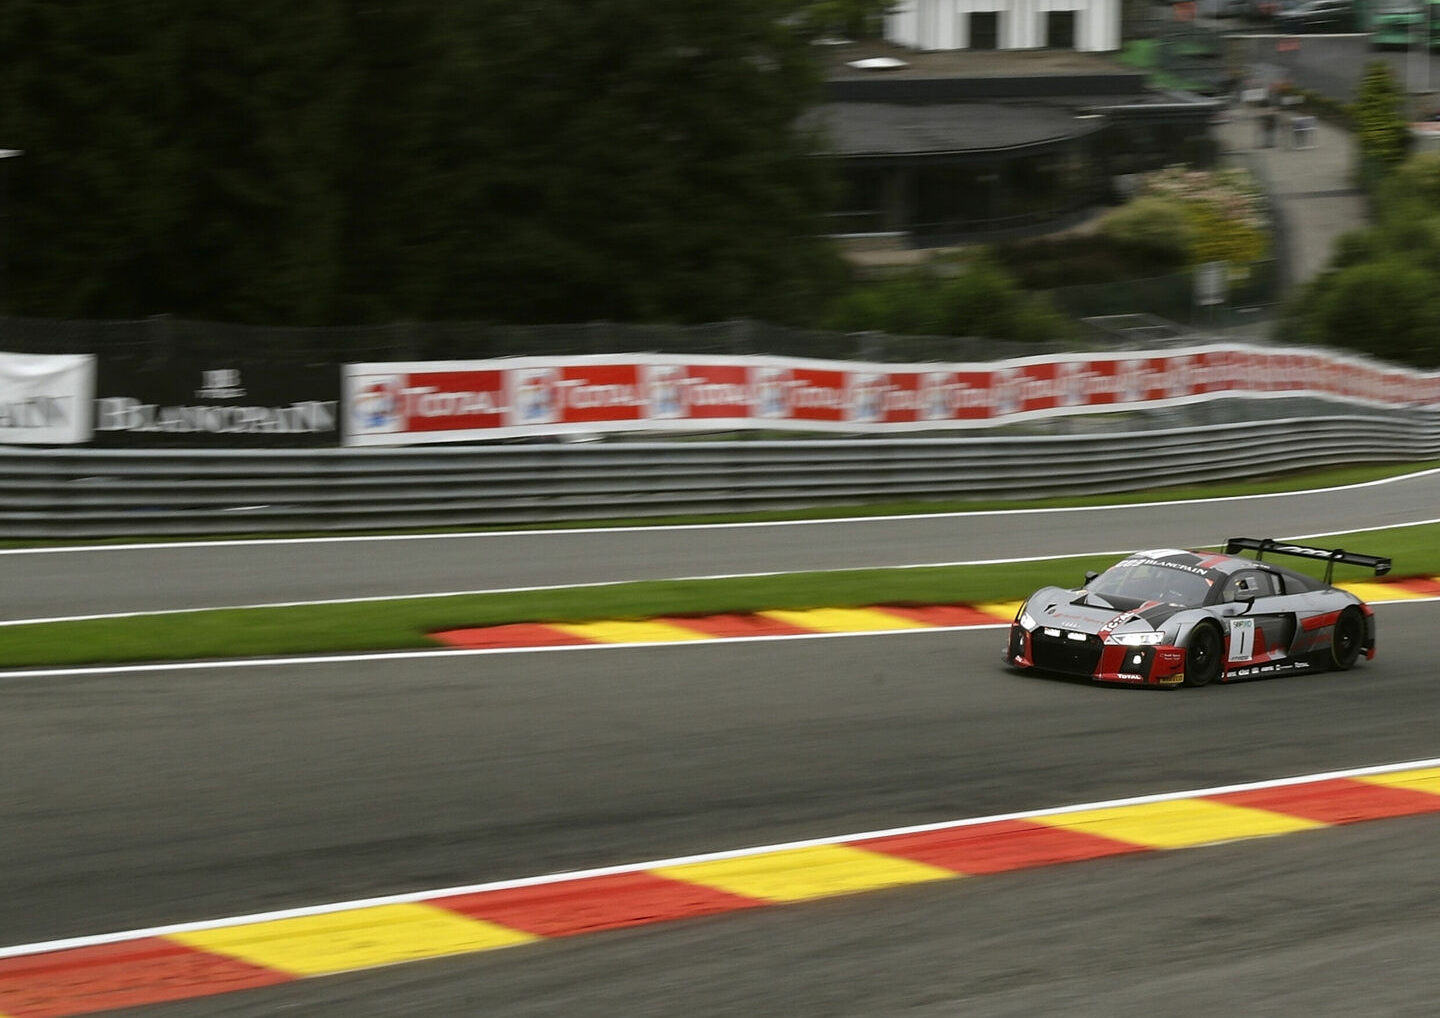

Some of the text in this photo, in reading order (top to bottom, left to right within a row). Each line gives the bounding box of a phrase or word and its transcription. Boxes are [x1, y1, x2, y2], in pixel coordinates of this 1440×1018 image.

[399, 386, 514, 418] TOTAL
[1144, 559, 1208, 576] BLANCPAIN
[1100, 611, 1135, 632] TOTAL
[1239, 631, 1245, 655] 1
